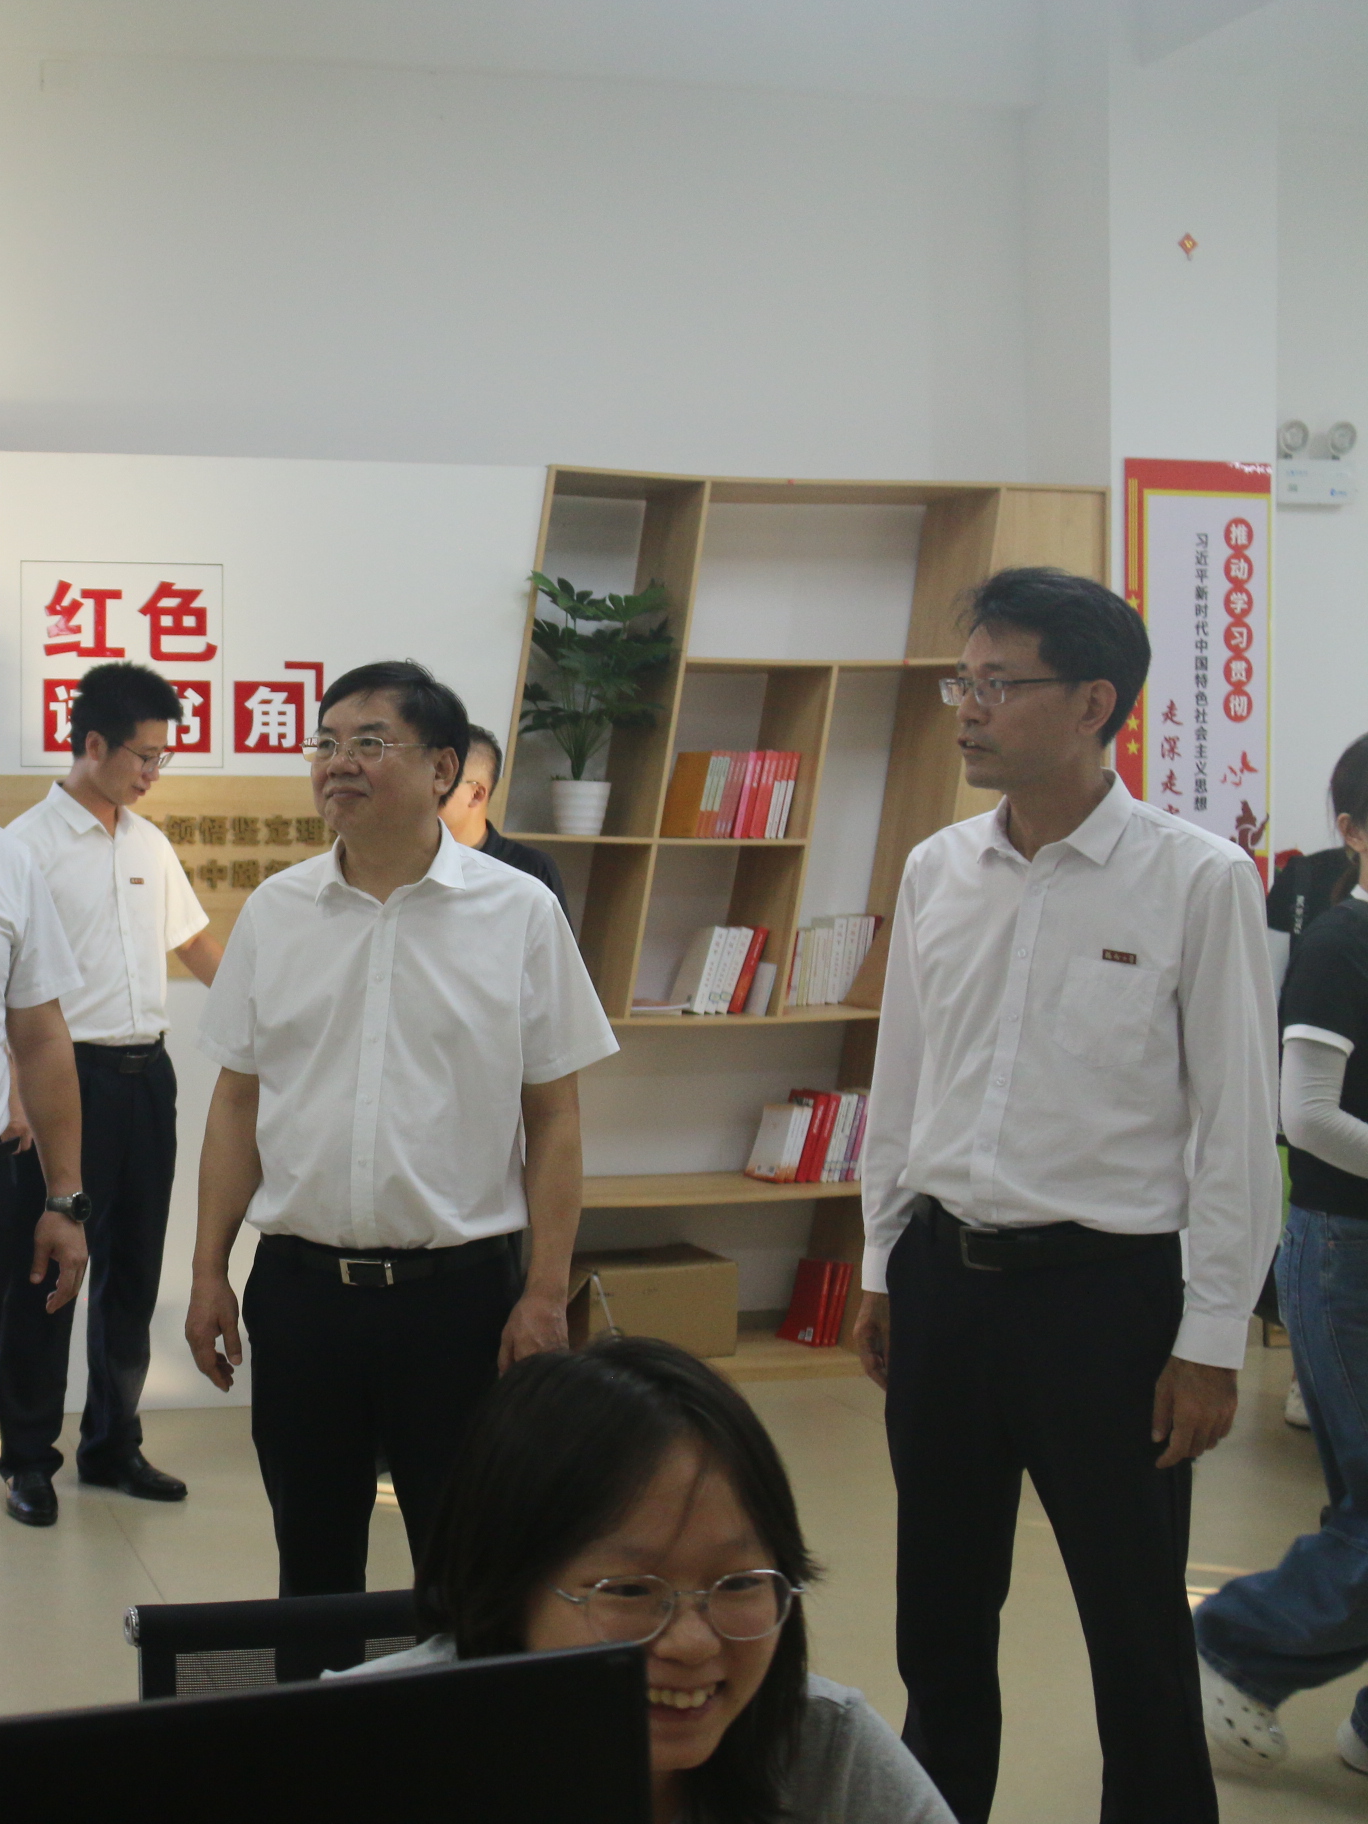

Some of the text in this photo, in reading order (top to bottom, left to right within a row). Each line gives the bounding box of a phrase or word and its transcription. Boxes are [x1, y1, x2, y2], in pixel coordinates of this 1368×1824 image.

[44, 580, 218, 662] 红色
[1194, 532, 1209, 812] 习近平新时代中国特色社会主义思想
[1228, 522, 1250, 718] 推动学习贯彻
